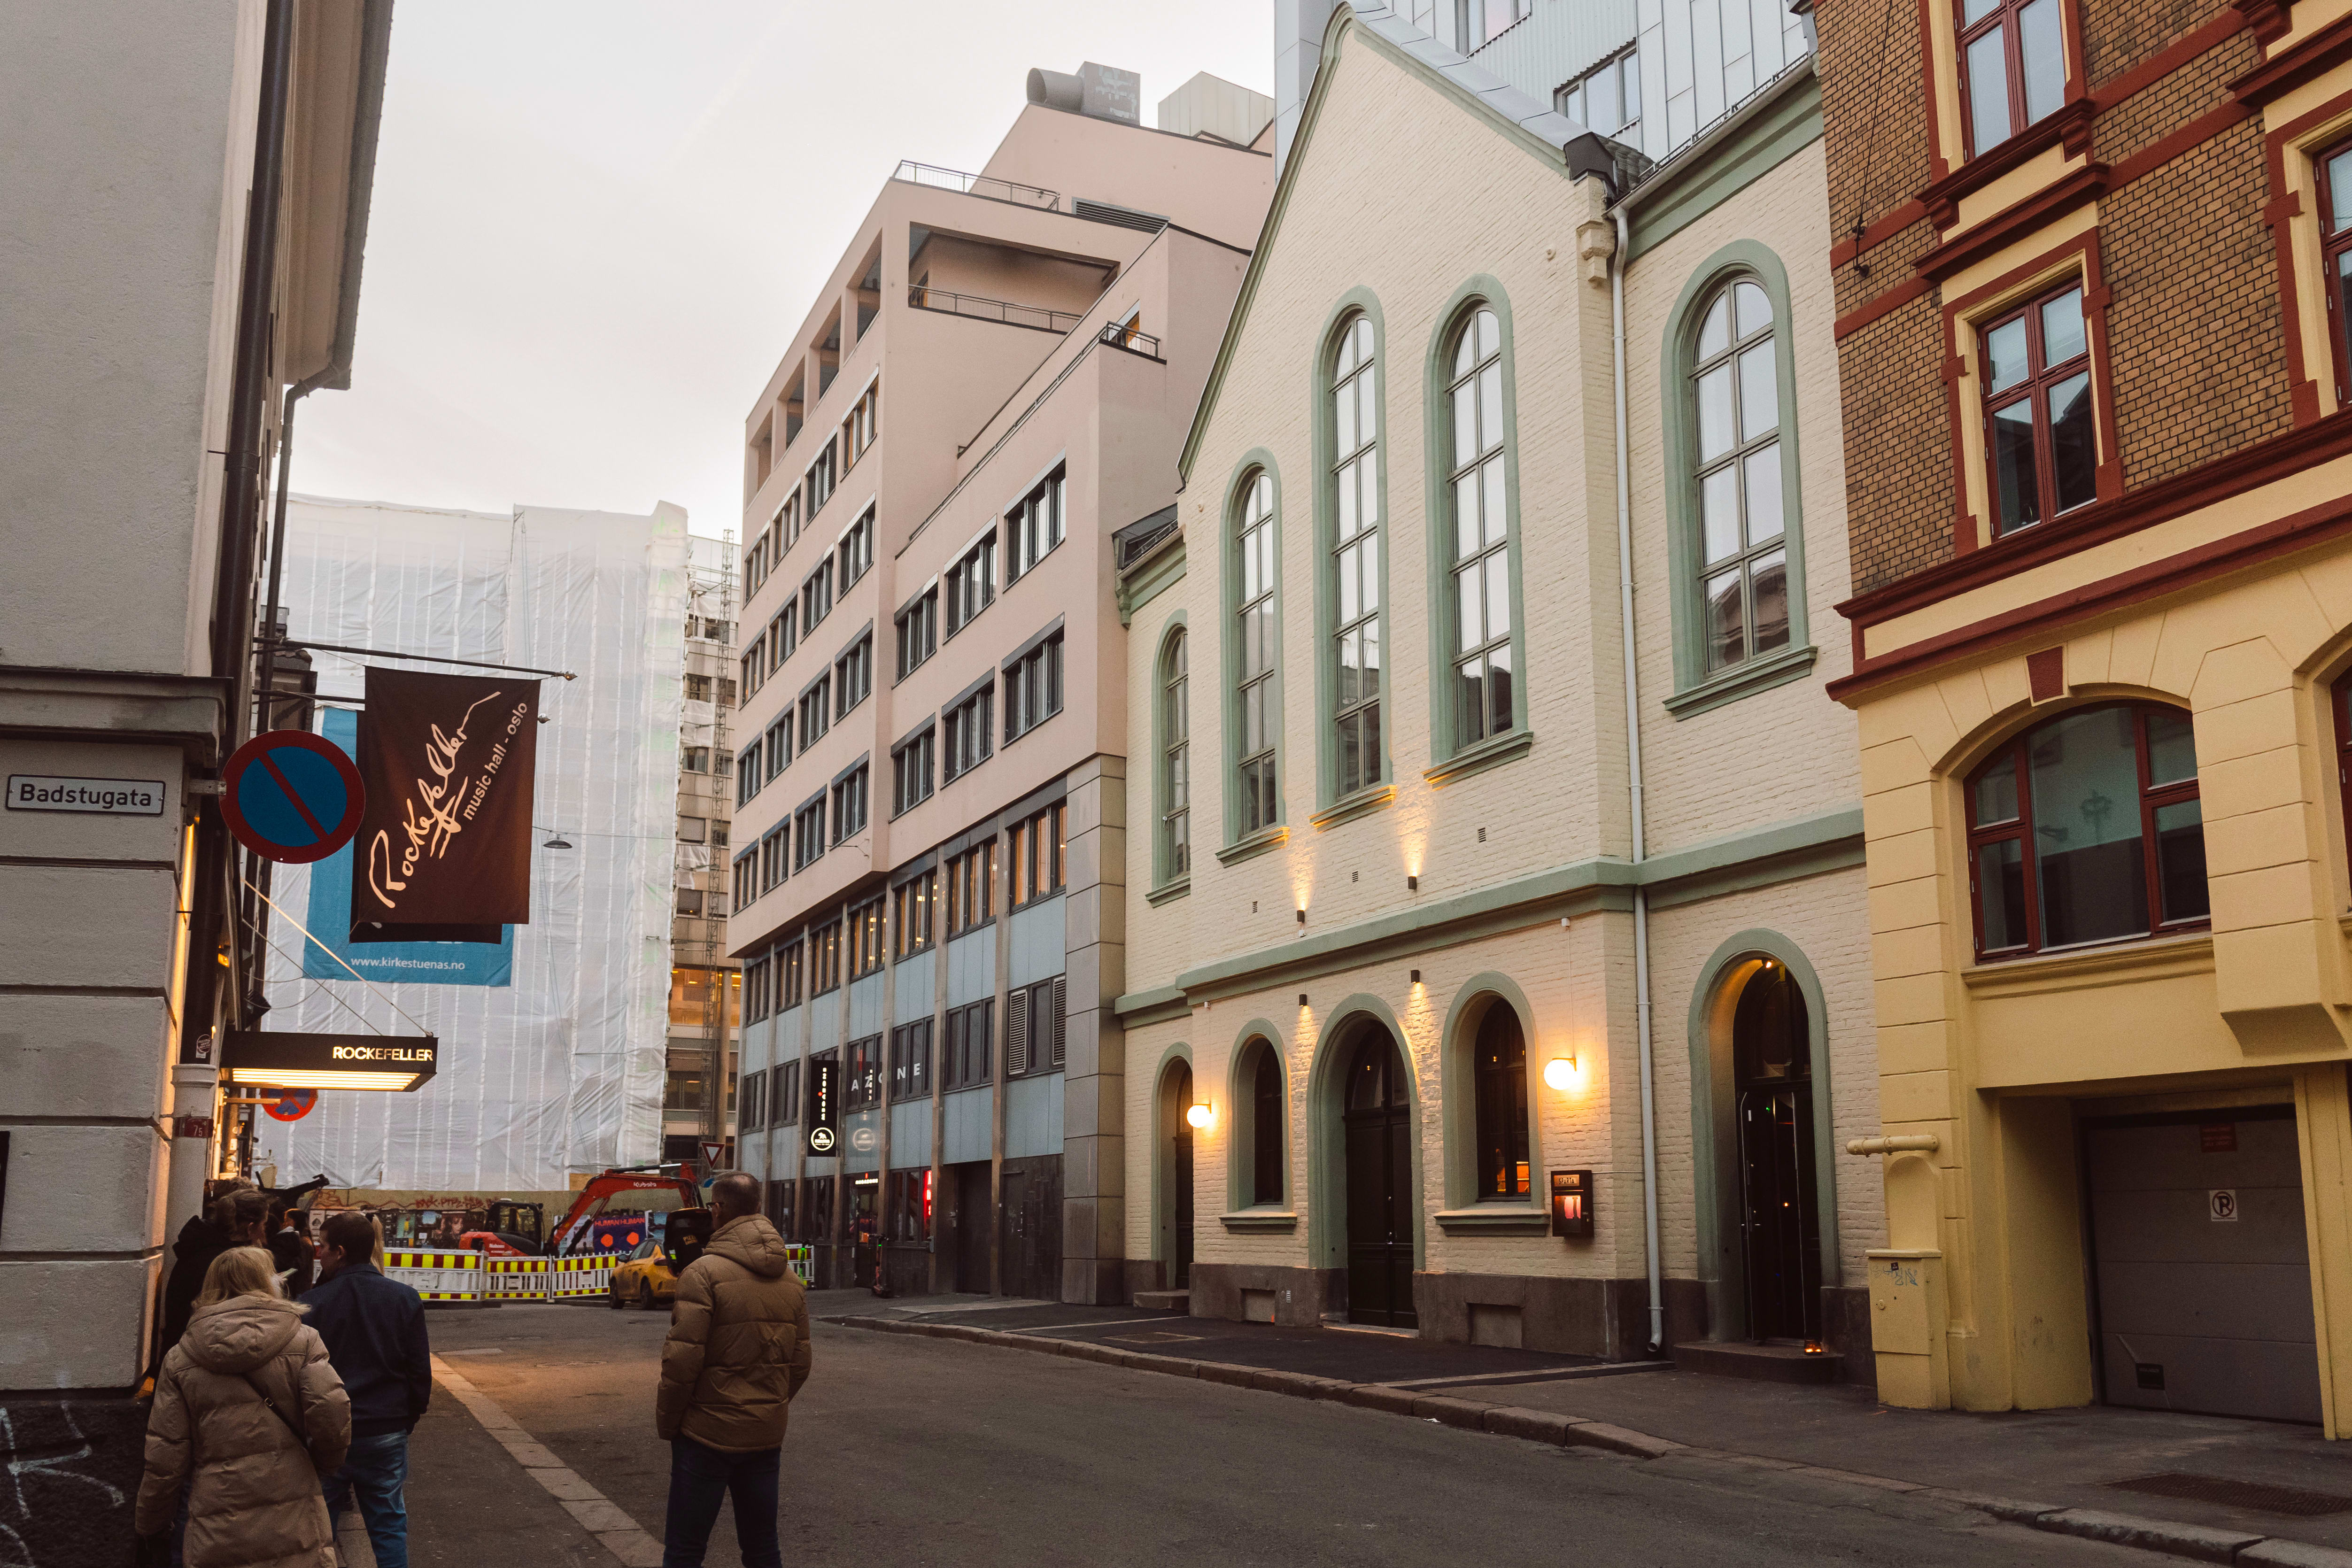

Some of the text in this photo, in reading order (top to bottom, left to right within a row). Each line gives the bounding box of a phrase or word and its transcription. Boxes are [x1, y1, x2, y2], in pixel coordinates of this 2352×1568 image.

[463, 774, 491, 820] music
[484, 746, 507, 774] hall
[507, 703, 528, 735] oslo
[20, 783, 152, 810] Badstugata
[369, 692, 501, 908] Rockefeller
[351, 957, 465, 970] www.kirkestuenas.no
[333, 1046, 433, 1061] ROCKEFELLER
